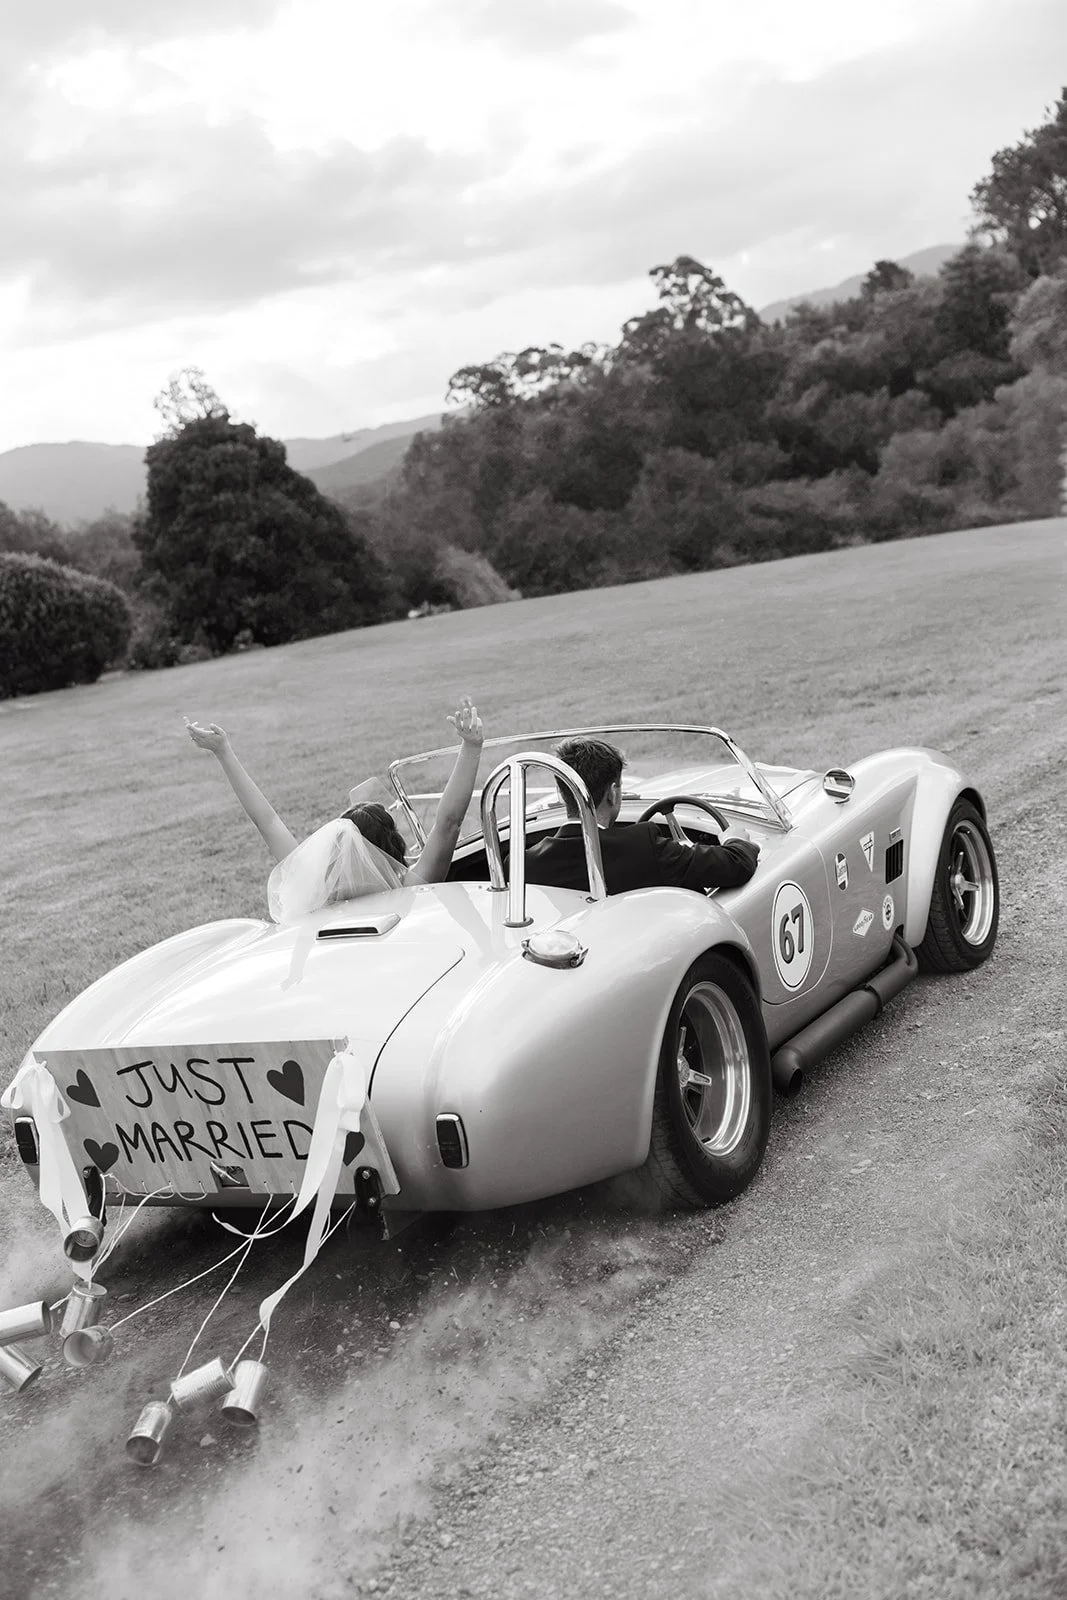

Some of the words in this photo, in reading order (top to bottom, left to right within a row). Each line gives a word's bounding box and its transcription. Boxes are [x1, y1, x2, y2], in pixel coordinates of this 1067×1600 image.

[779, 903, 804, 964] 67
[117, 1057, 255, 1108] JUST
[115, 1120, 313, 1164] MARRIED
